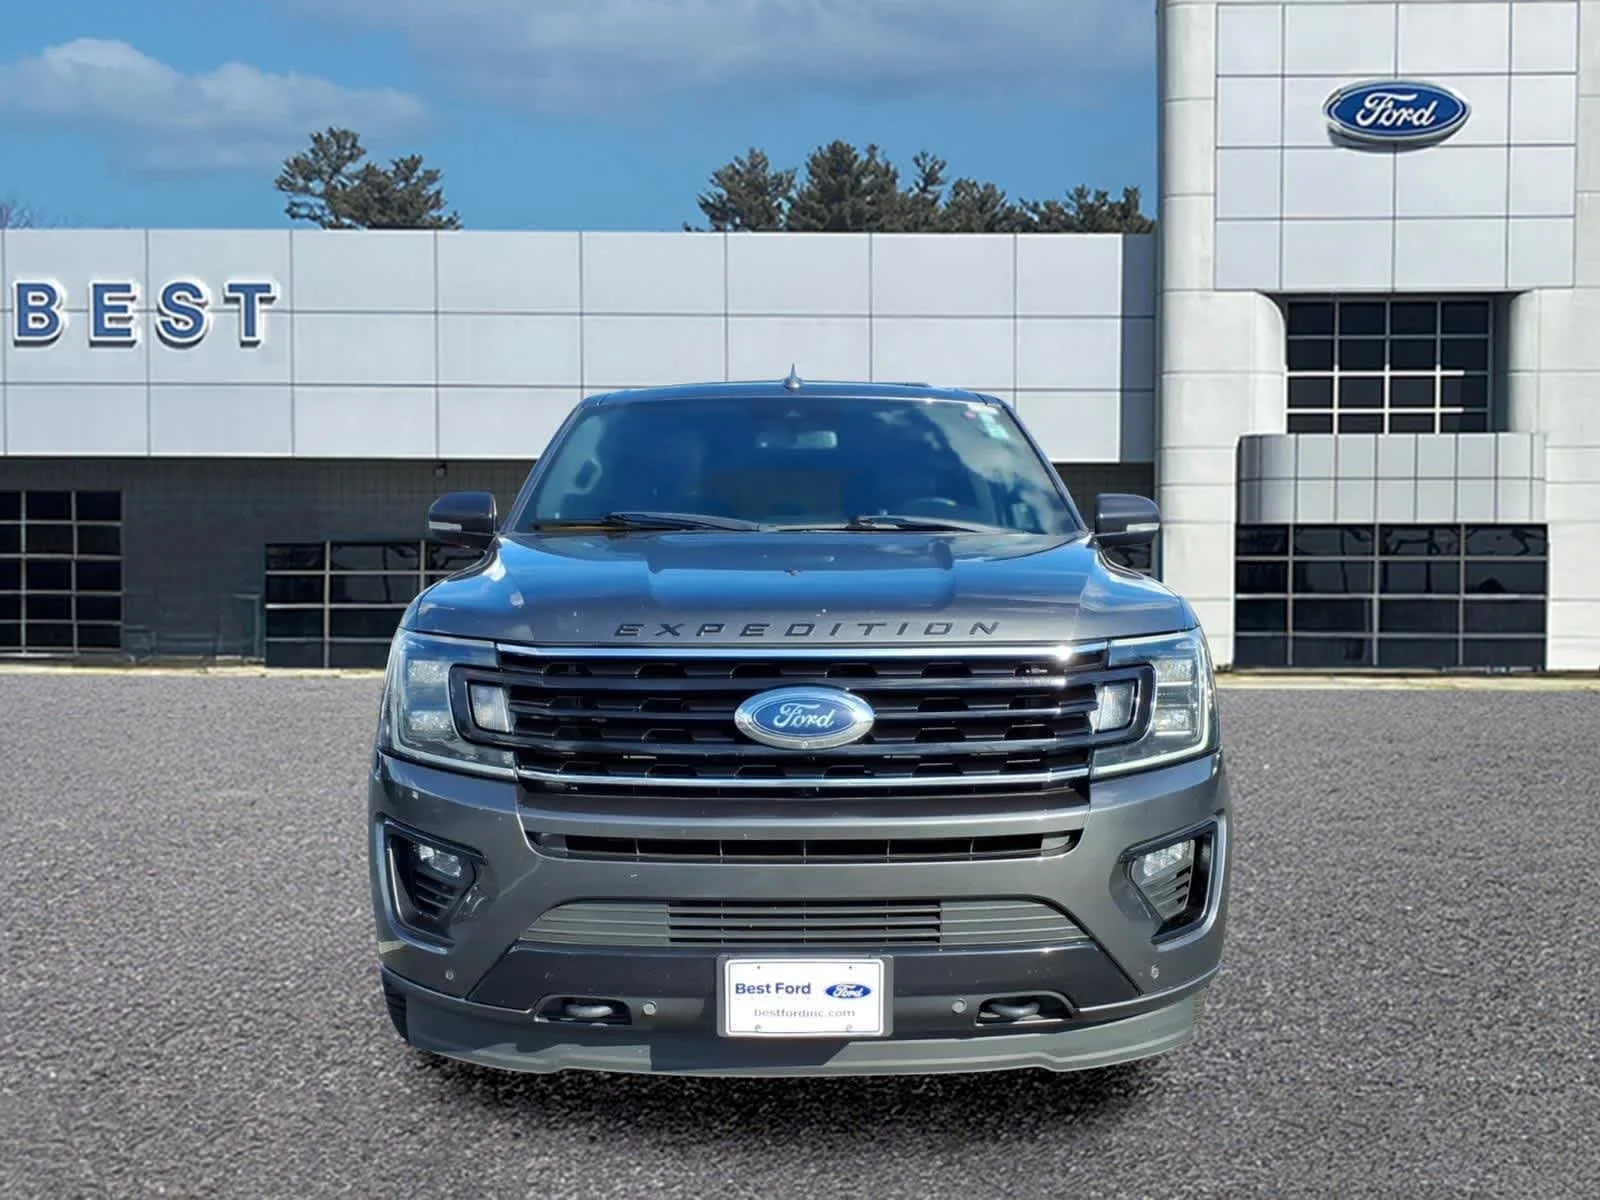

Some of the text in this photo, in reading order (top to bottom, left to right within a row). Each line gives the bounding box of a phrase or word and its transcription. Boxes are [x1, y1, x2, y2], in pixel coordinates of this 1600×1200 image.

[1355, 92, 1438, 127] Ford
[14, 280, 277, 345] BEST
[614, 621, 1000, 637] EXPEDITION
[773, 702, 835, 729] Ford
[735, 983, 811, 994] Best Ford
[832, 984, 865, 999] Ford
